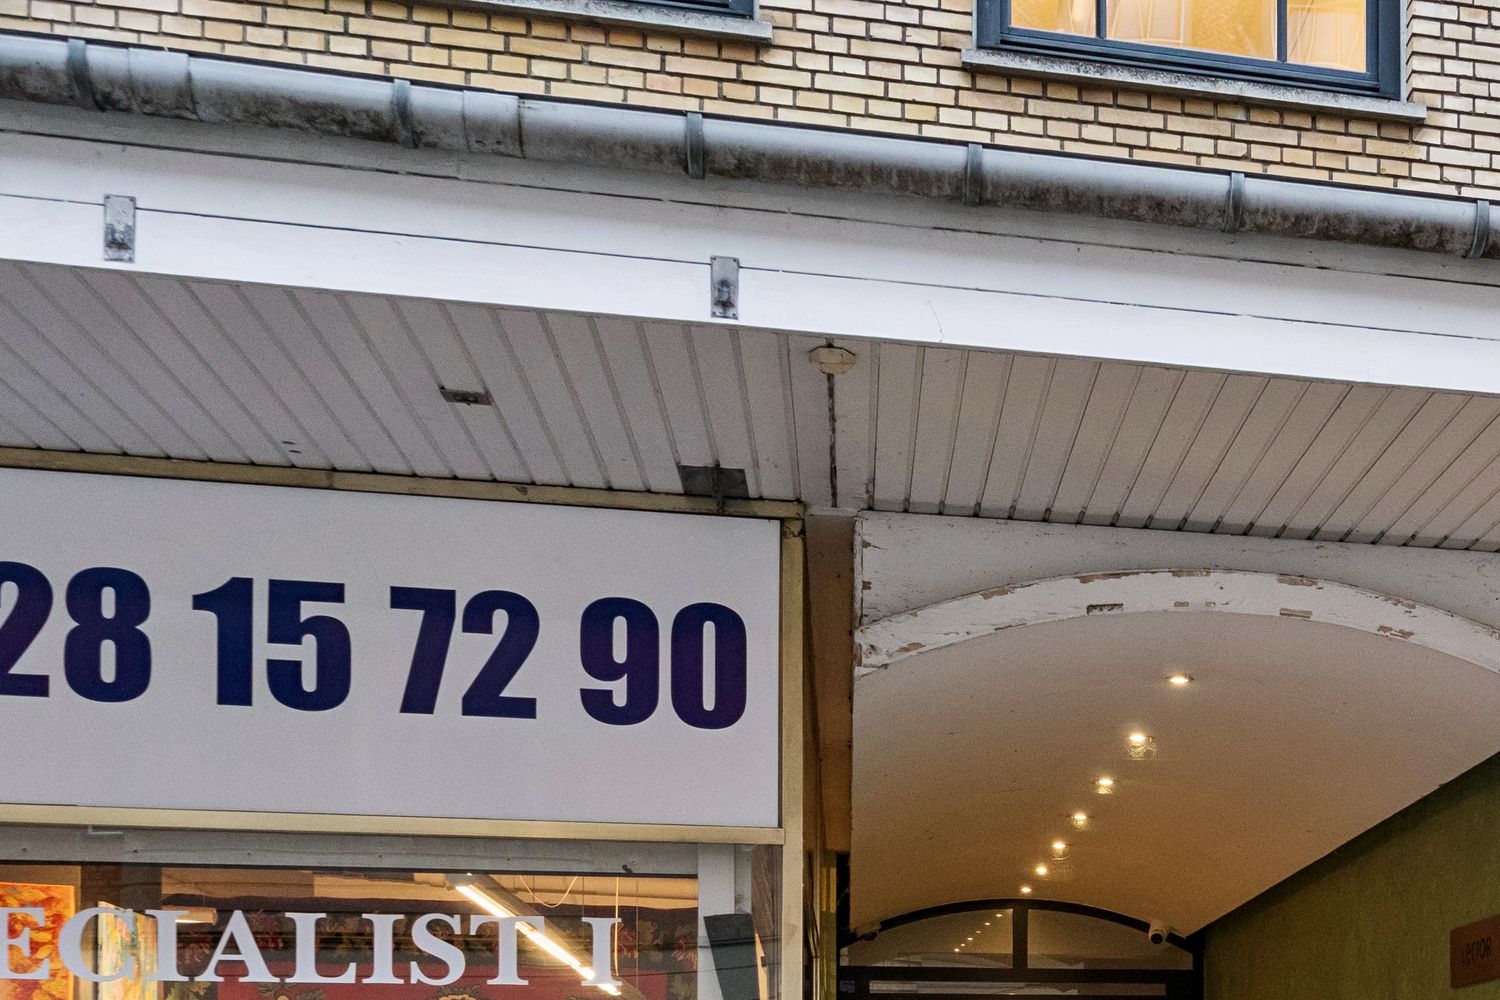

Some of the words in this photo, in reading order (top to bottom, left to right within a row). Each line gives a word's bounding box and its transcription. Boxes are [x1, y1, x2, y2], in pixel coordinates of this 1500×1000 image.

[0, 561, 152, 703] 28
[192, 576, 352, 712] 15
[389, 585, 541, 720] 72
[579, 596, 748, 730] 90
[0, 906, 547, 987] ECIALIST
[580, 916, 623, 988] I
